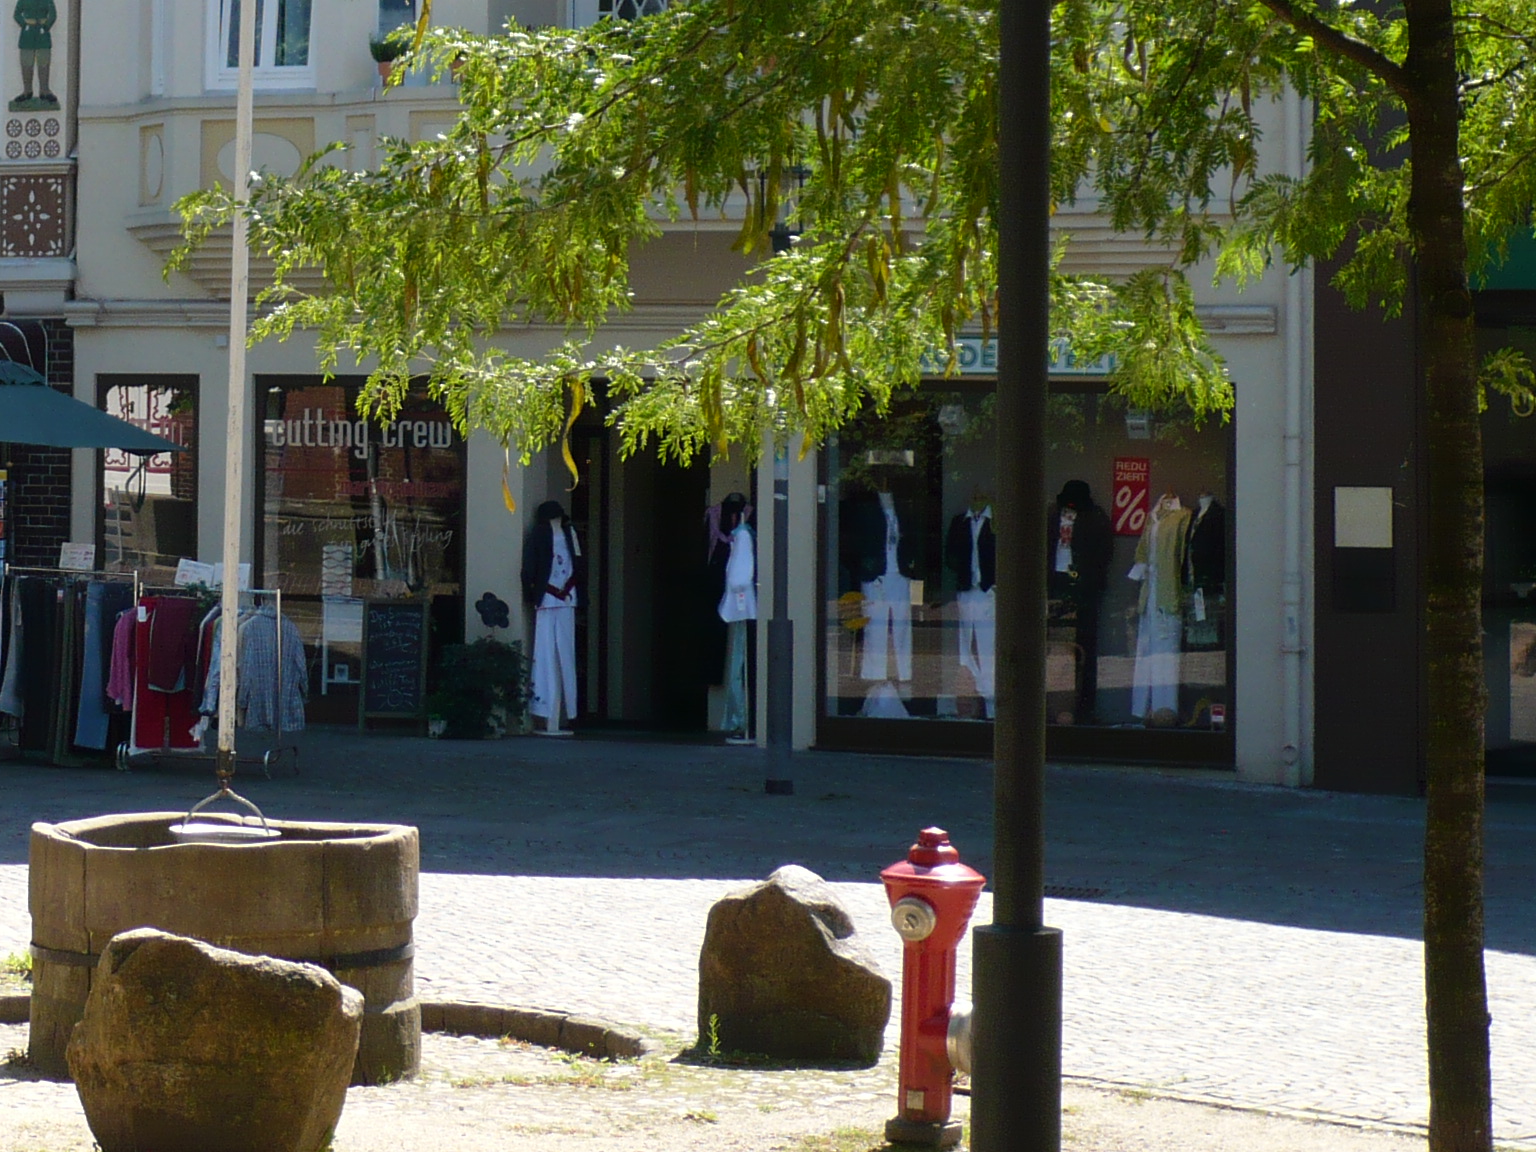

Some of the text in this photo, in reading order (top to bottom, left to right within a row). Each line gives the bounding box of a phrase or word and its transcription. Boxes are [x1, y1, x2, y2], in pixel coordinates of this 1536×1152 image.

[271, 407, 452, 460] cutting crew
[1115, 485, 1147, 532] %
